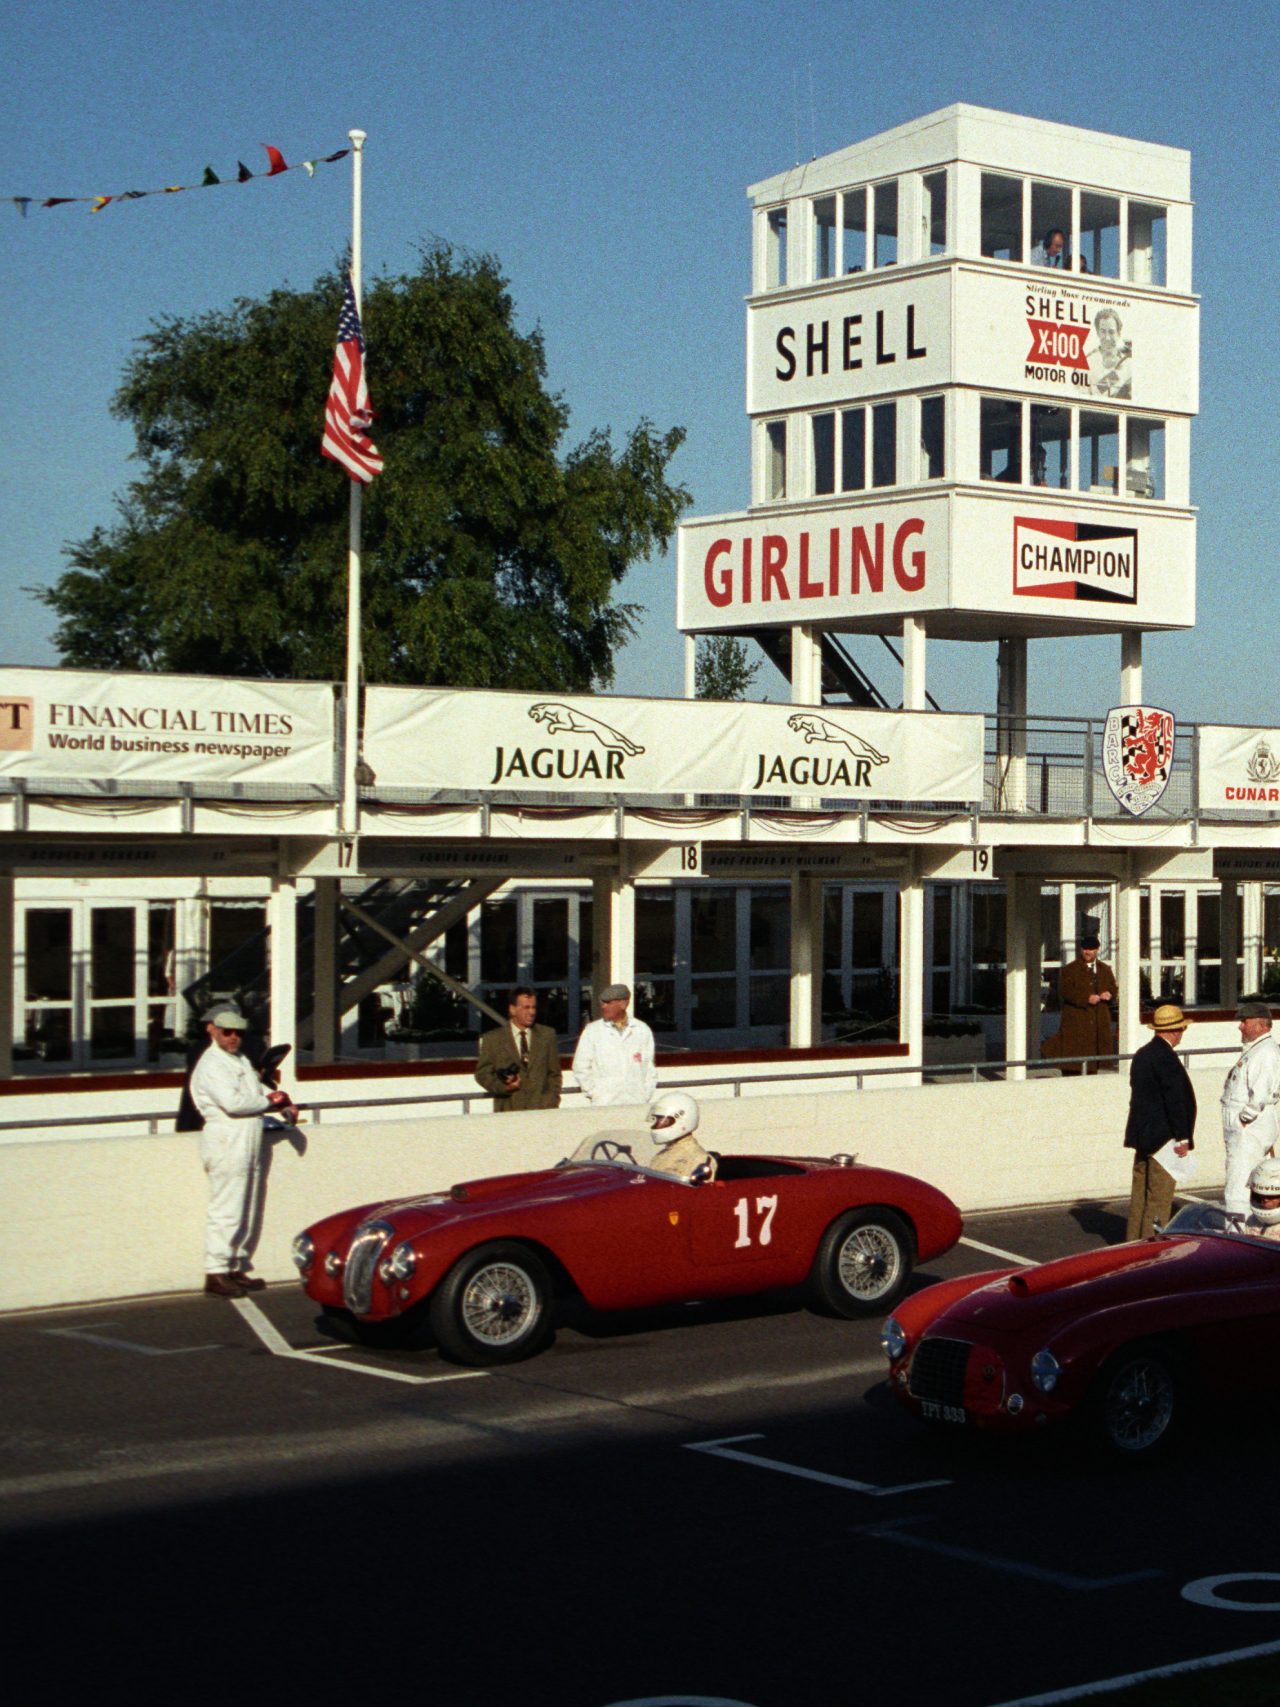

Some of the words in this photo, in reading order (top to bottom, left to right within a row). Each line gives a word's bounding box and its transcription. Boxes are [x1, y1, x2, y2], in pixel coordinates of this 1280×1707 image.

[1026, 295, 1091, 325] SHELL
[776, 304, 927, 382] SHELL
[1038, 328, 1080, 360] X-100
[1025, 364, 1066, 383] MOTOR
[1071, 371, 1091, 387] OIL
[703, 517, 927, 608] GIRLING
[1019, 542, 1132, 580] CHAMPION
[0, 702, 30, 730] T
[48, 702, 207, 733] FINANCIAL
[210, 710, 293, 736] TIMES
[48, 732, 106, 751] World
[110, 736, 190, 754] business
[194, 742, 292, 760] newspaper
[491, 745, 626, 785] JAGUAR
[752, 754, 872, 790] JAGUAR
[338, 840, 353, 869] 17
[681, 845, 698, 871] 18
[972, 846, 989, 873] 19
[733, 1194, 779, 1249] 17
